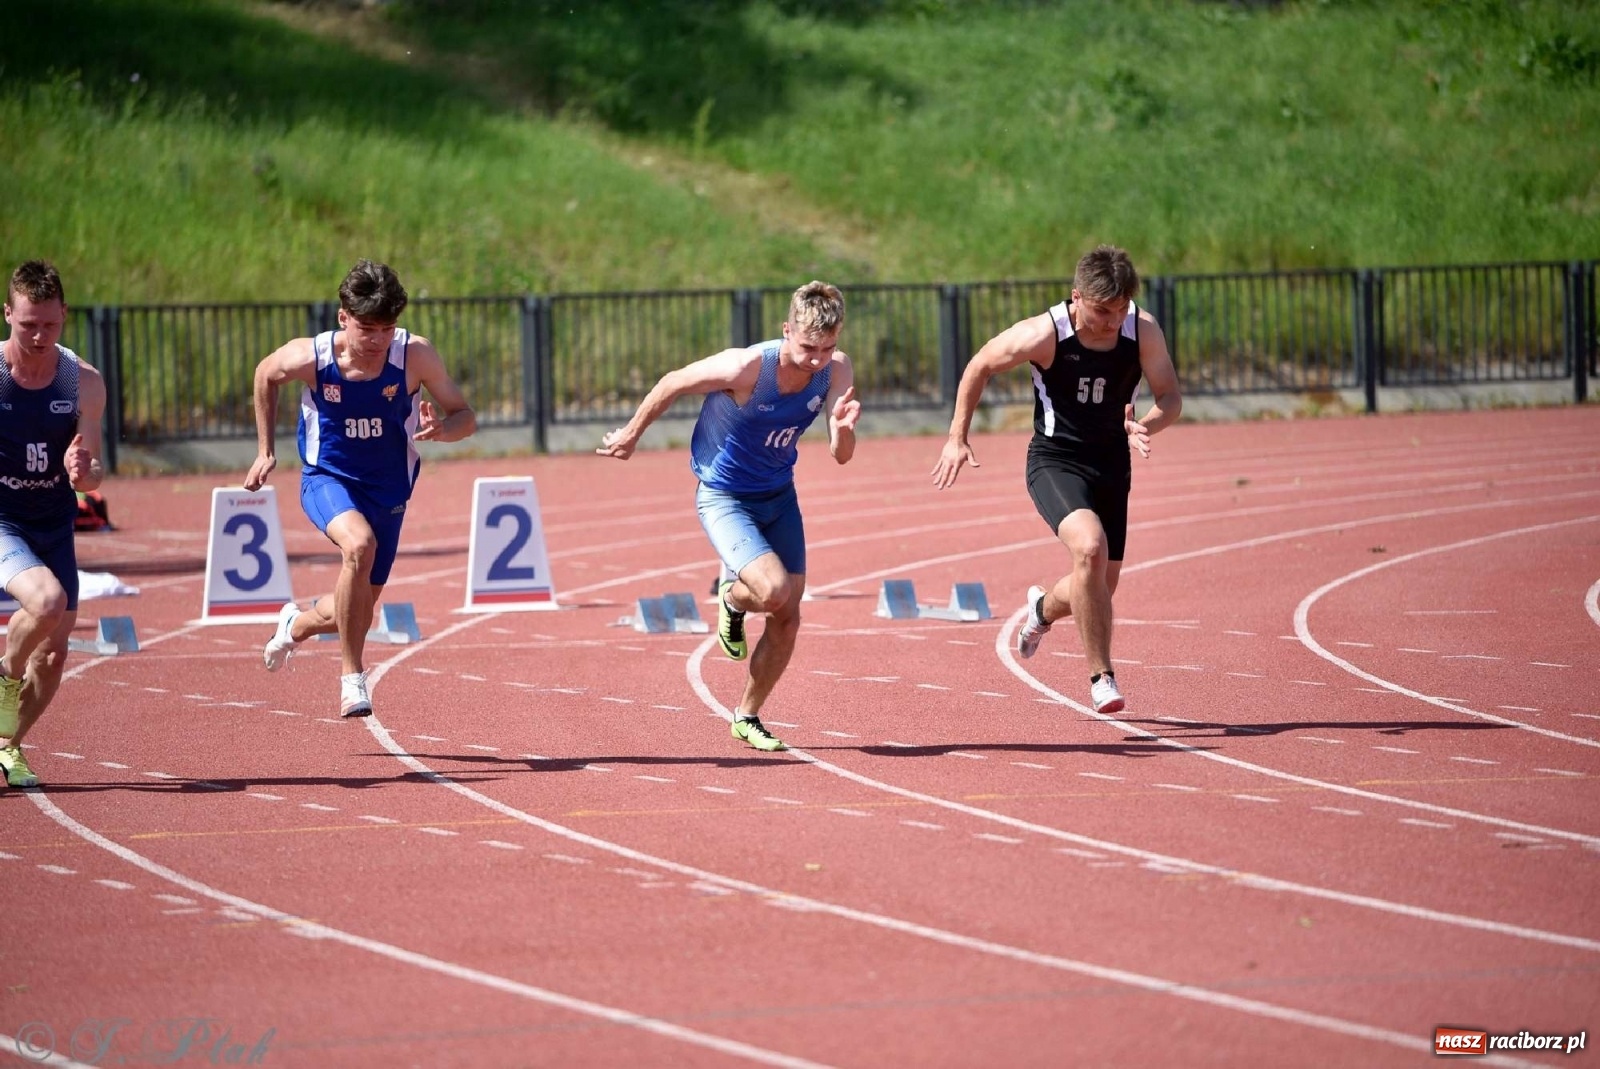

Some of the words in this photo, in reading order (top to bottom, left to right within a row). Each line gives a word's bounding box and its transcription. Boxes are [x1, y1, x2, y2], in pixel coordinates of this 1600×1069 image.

[1076, 377, 1107, 404] 56
[345, 417, 383, 440] 303
[26, 442, 49, 473] 95
[223, 513, 273, 592] 3
[485, 503, 535, 581] 2
